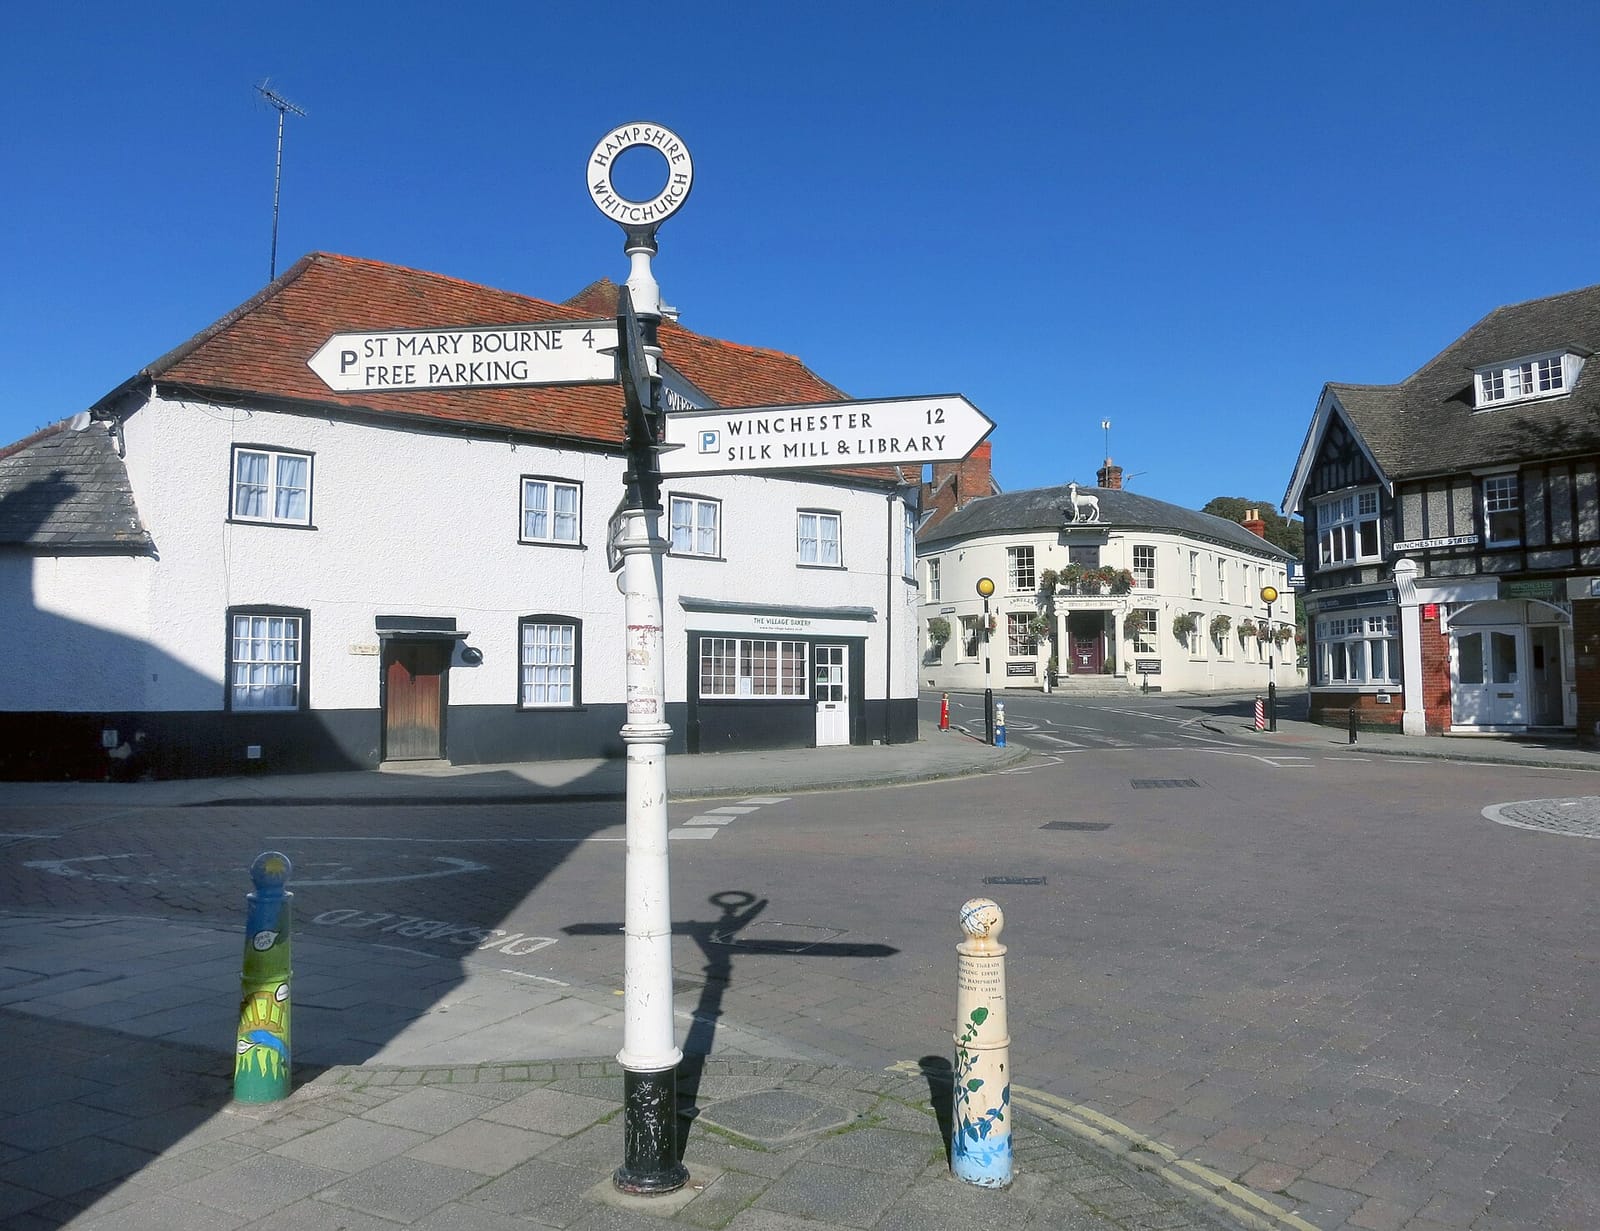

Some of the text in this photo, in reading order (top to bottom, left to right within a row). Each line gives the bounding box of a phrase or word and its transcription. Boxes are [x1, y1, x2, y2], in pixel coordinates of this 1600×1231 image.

[594, 127, 686, 167] HAMPSHIRE
[593, 173, 688, 221] WHITCHURCH
[364, 329, 595, 358] ST MARY BOURNE 4
[340, 350, 358, 373] P
[365, 361, 528, 386] FREE PARKING
[728, 408, 945, 436] WINCHESTER 12
[702, 432, 716, 450] P
[728, 435, 947, 461] SILK MILL & LIBRARY
[1395, 536, 1478, 550] WINCHESTER STREET
[753, 617, 764, 625] THE
[766, 618, 789, 626] VILLAGE
[311, 909, 559, 956] DISABLED
